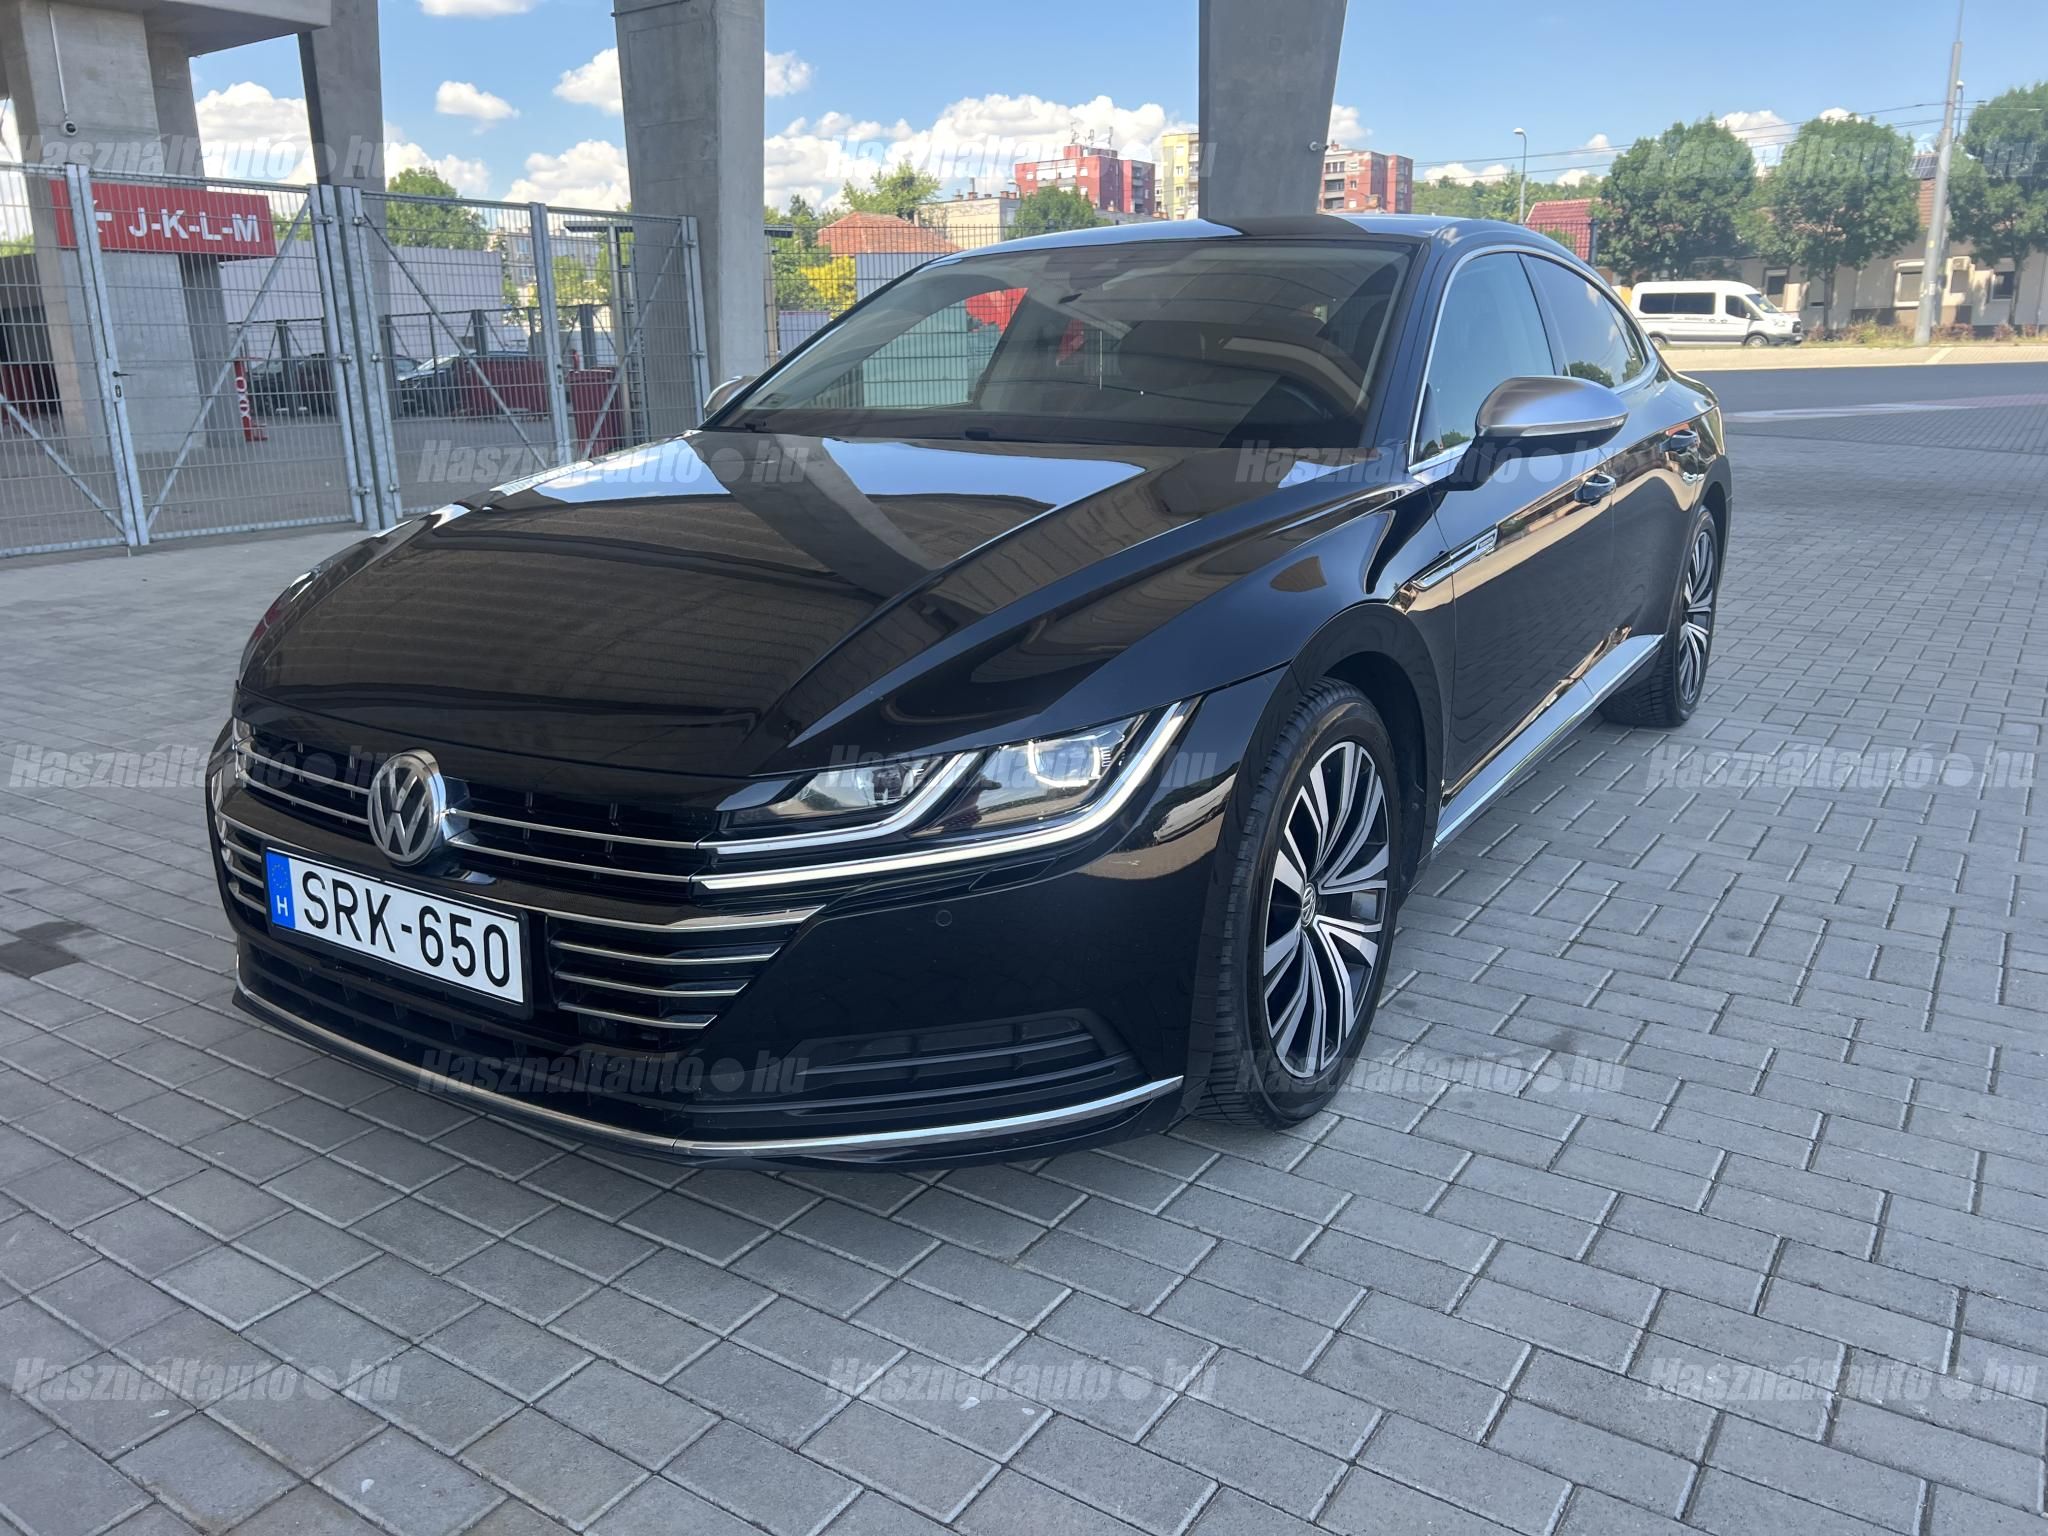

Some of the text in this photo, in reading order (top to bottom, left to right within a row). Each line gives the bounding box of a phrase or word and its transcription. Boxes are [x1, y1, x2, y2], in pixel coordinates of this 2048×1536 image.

[128, 206, 261, 243] J-K-L-M
[276, 894, 289, 918] H
[302, 870, 510, 988] SRK-650
